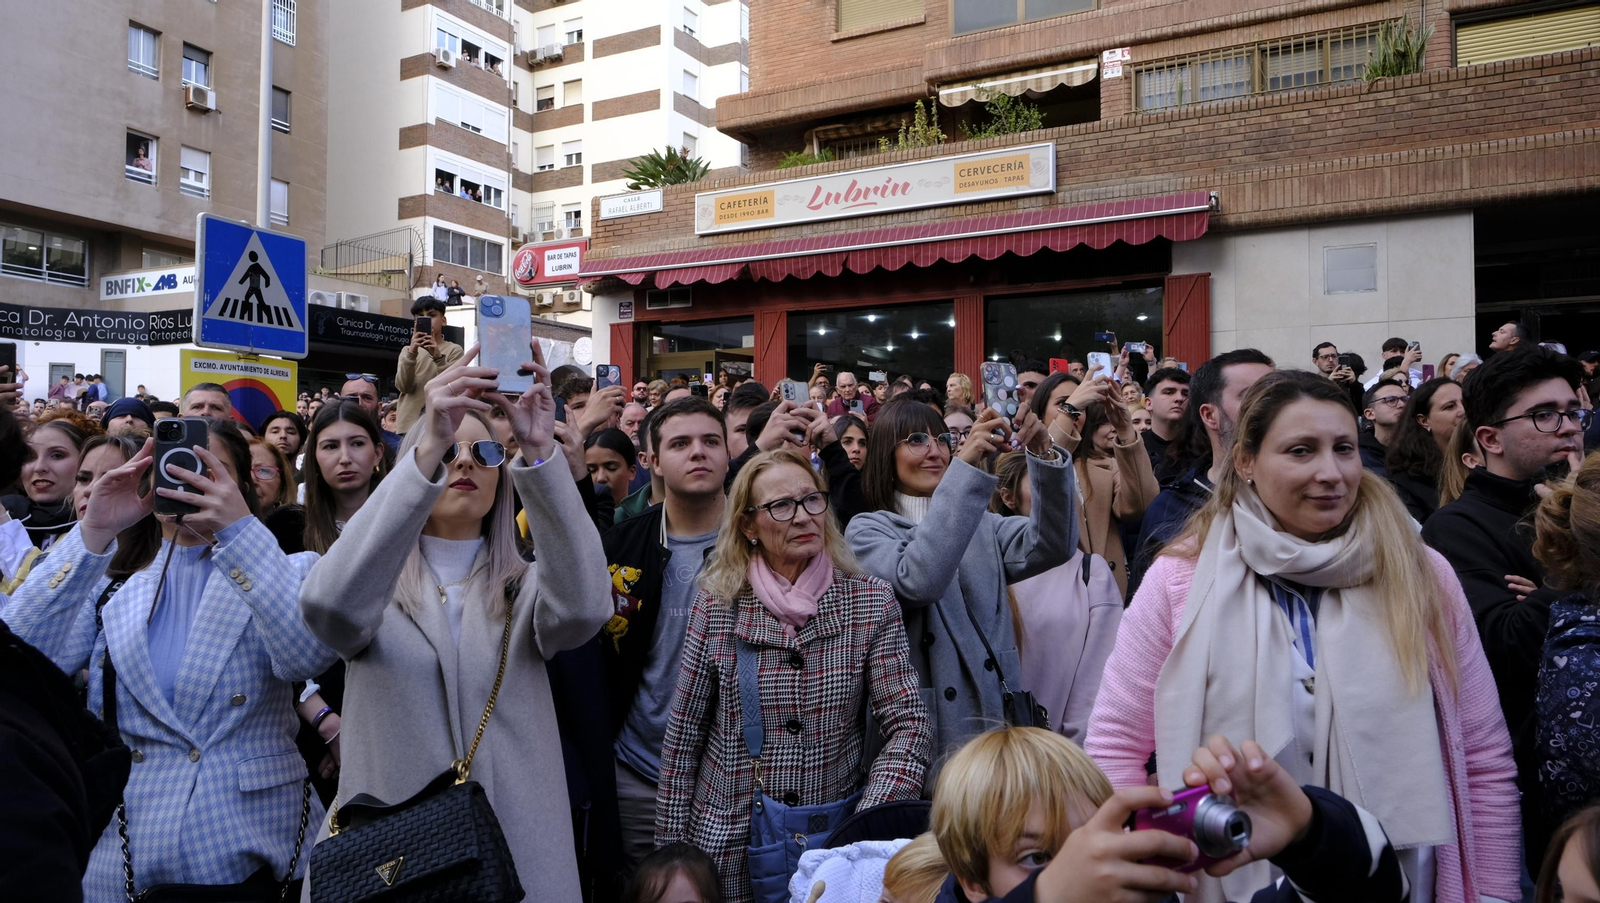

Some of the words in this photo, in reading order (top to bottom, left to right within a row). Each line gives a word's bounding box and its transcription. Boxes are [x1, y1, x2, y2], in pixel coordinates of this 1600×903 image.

[959, 160, 1024, 178] CERVECERÍA
[959, 178, 998, 189] DESAYUNOS
[1004, 174, 1025, 183] TAPAS
[608, 205, 629, 215] RAFAEL
[630, 202, 653, 212] ALBERTI
[719, 196, 769, 211] CAFETERÍA
[740, 210, 755, 218] 1990
[757, 208, 769, 216] BAR
[563, 251, 577, 259] TAPAS
[551, 263, 573, 272] LUBRIN
[183, 275, 194, 285] AU
[29, 309, 57, 327] Dr.
[64, 312, 146, 330] Antonio
[178, 312, 193, 328] Lu
[2, 325, 76, 342] matología
[82, 331, 90, 341] y
[96, 328, 148, 344] Cirugía
[365, 320, 377, 331] Dr.
[378, 323, 409, 336] Antonio
[194, 361, 218, 370] EXCMO.
[220, 364, 263, 374] AYUNTAMIENTO
[264, 367, 270, 375] DE
[270, 368, 289, 378] ALMERIA
